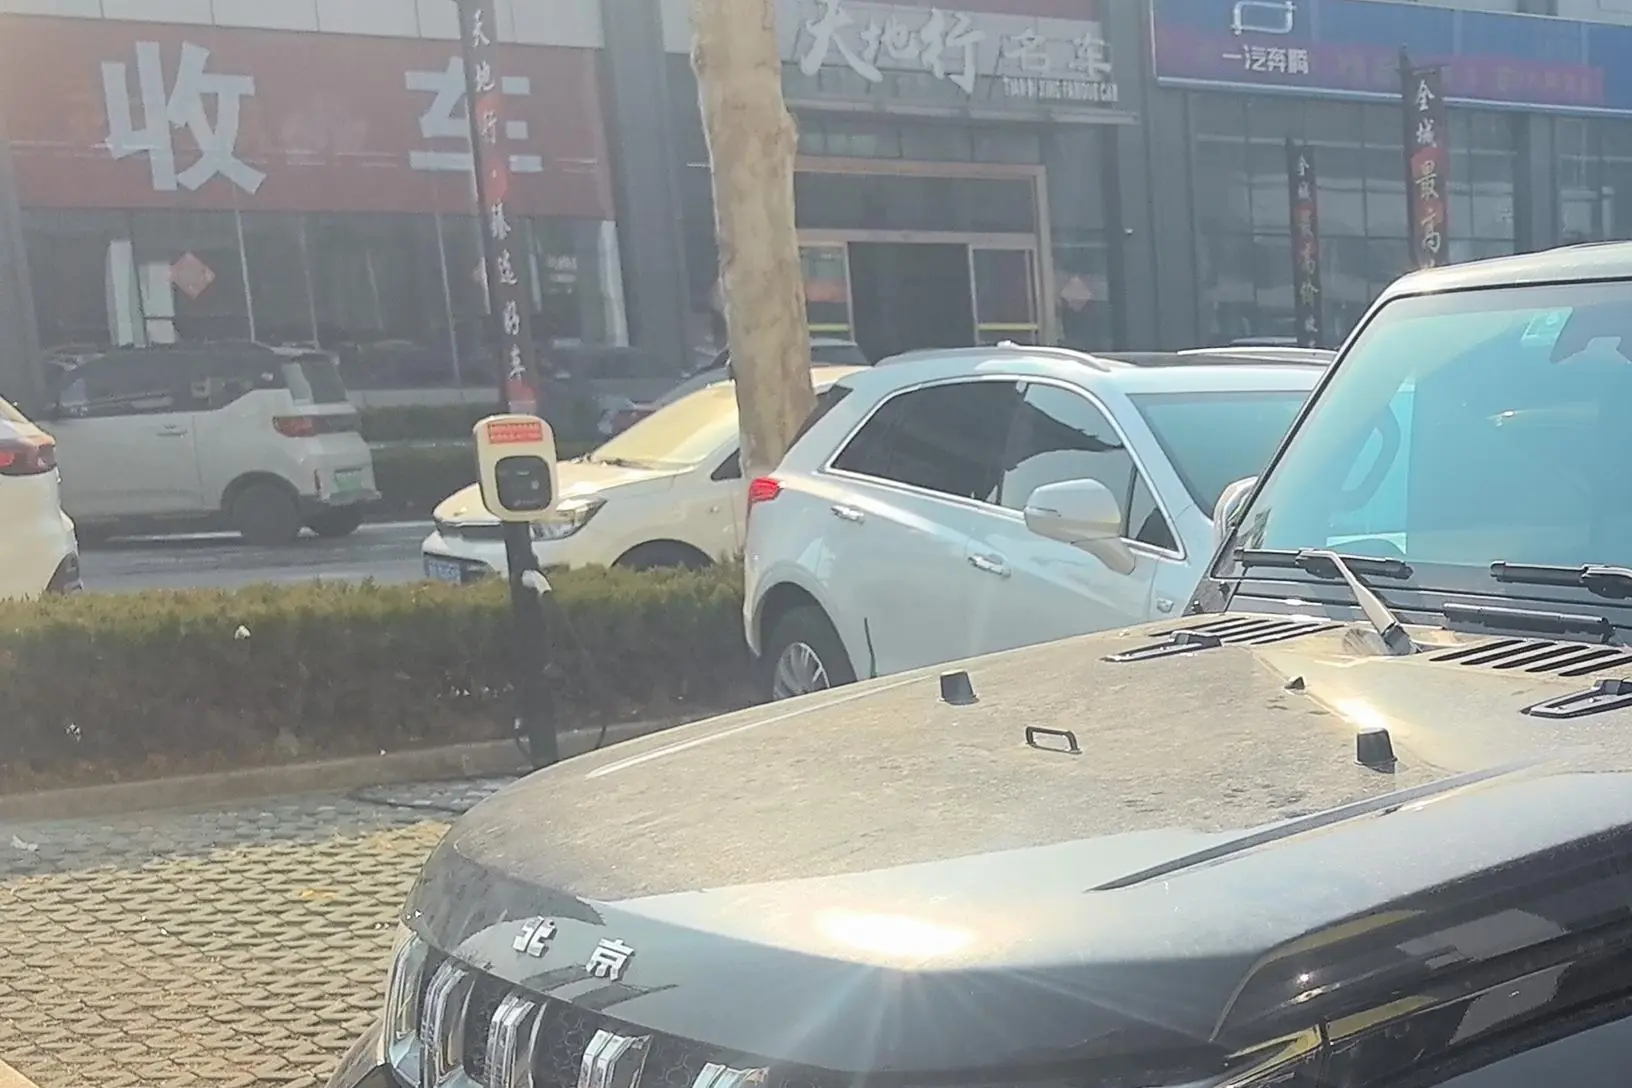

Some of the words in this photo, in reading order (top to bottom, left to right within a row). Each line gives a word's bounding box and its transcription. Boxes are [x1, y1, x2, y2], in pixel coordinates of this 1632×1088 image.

[1222, 44, 1309, 75] 一汽奔腾
[1415, 79, 1442, 268] 全城最高
[512, 915, 636, 981] 北京
